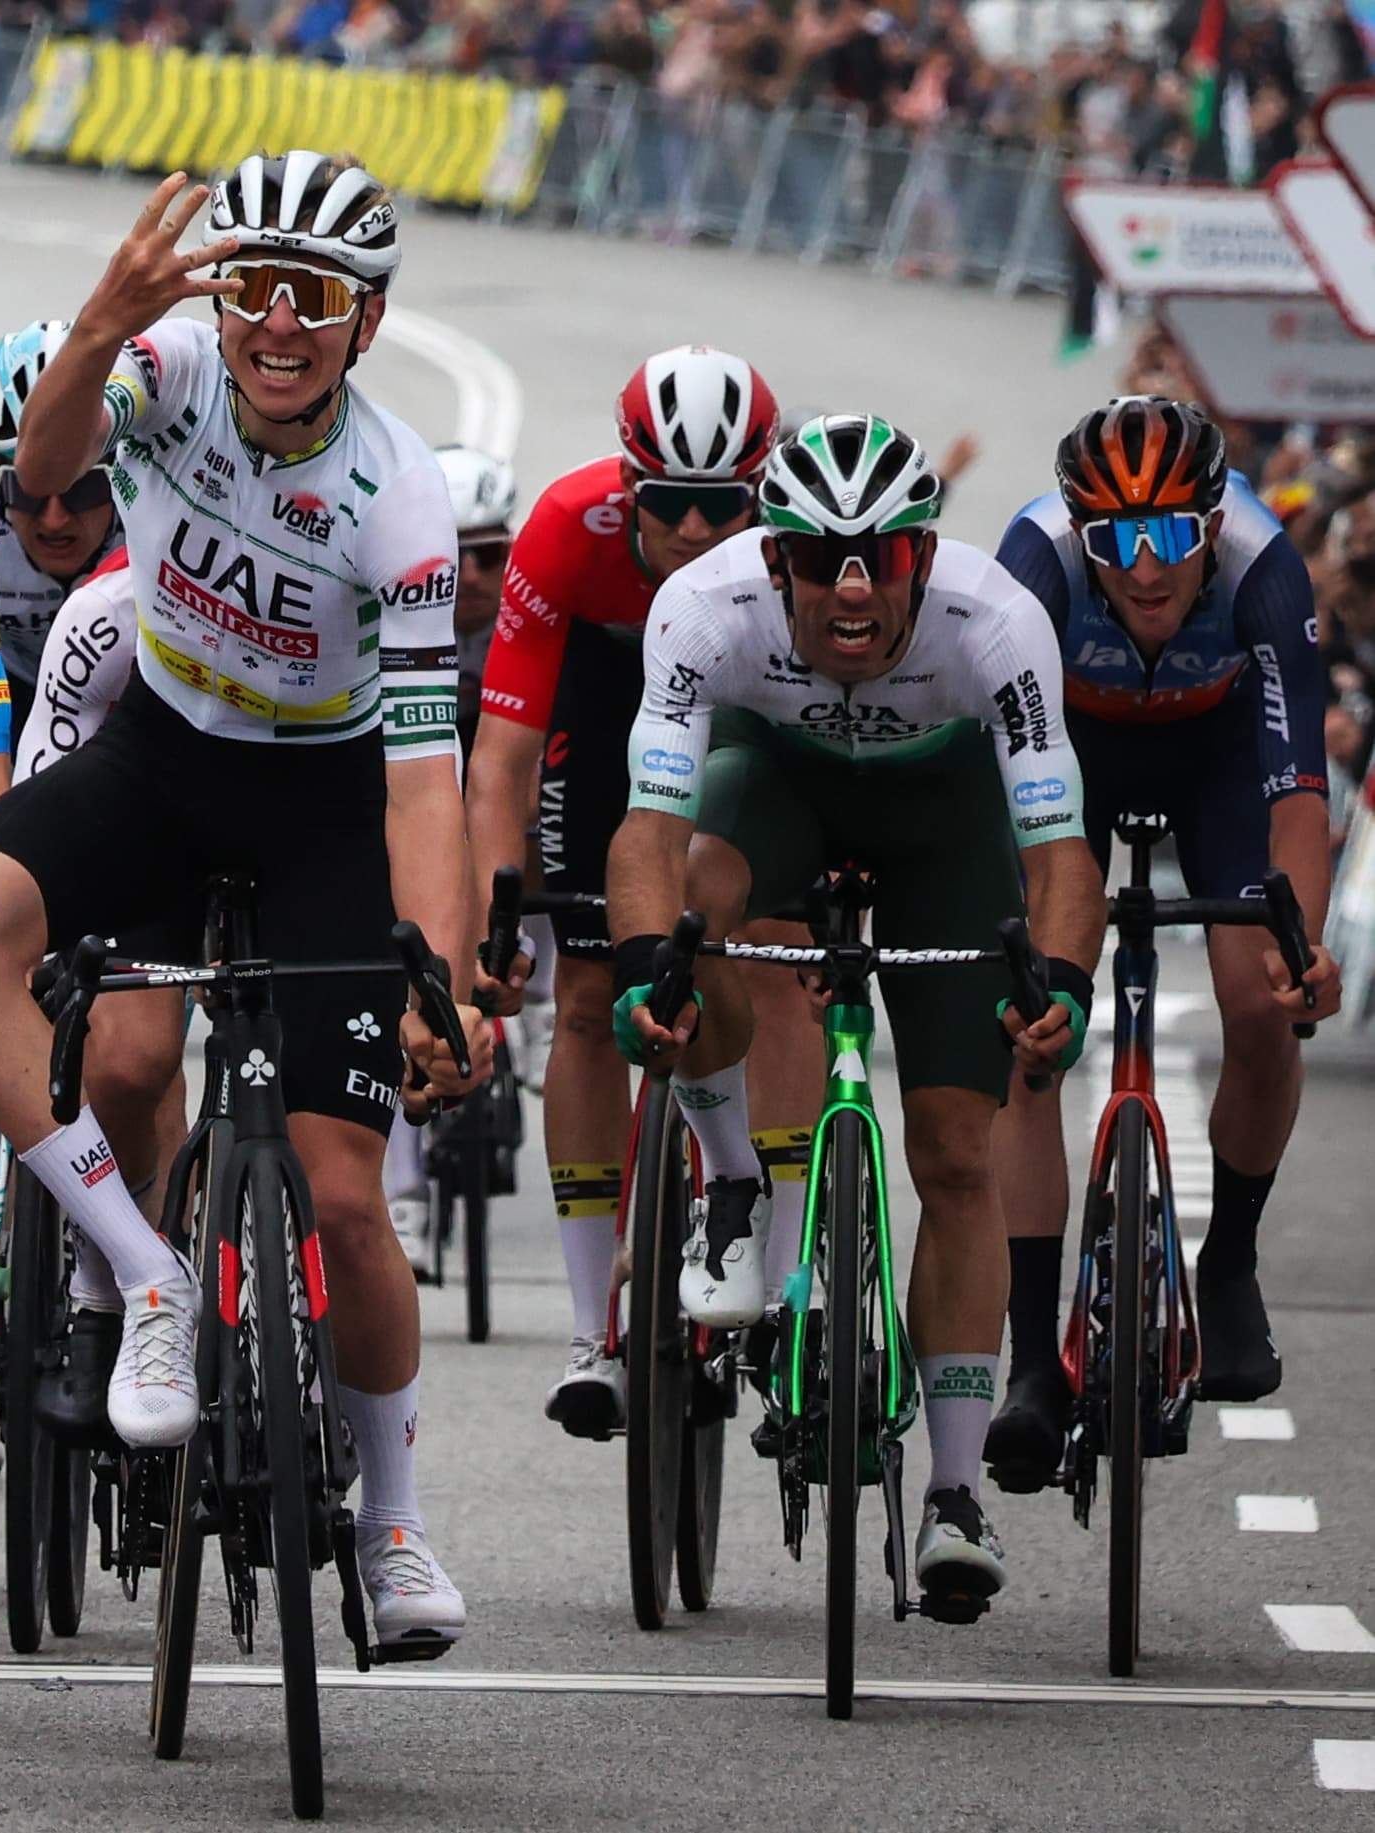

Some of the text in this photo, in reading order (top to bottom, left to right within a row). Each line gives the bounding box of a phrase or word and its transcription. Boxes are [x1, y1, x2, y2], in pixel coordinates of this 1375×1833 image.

[259, 233, 306, 247] MET
[271, 493, 332, 541] Volta
[169, 518, 314, 629] UAE
[380, 572, 455, 607] Volta
[162, 571, 314, 656] Emirates
[30, 616, 122, 778] Cofidis
[799, 703, 907, 723] CAJA
[1017, 669, 1049, 755] SEGUROS
[1252, 643, 1291, 744] GIANT
[233, 967, 272, 978] wahoo
[725, 942, 826, 963] Vision
[878, 947, 982, 965] Vision
[220, 1065, 231, 1115] LOOK
[346, 1067, 400, 1111] Emi
[70, 1139, 111, 1176] UAE
[942, 1366, 992, 1378] CAJA
